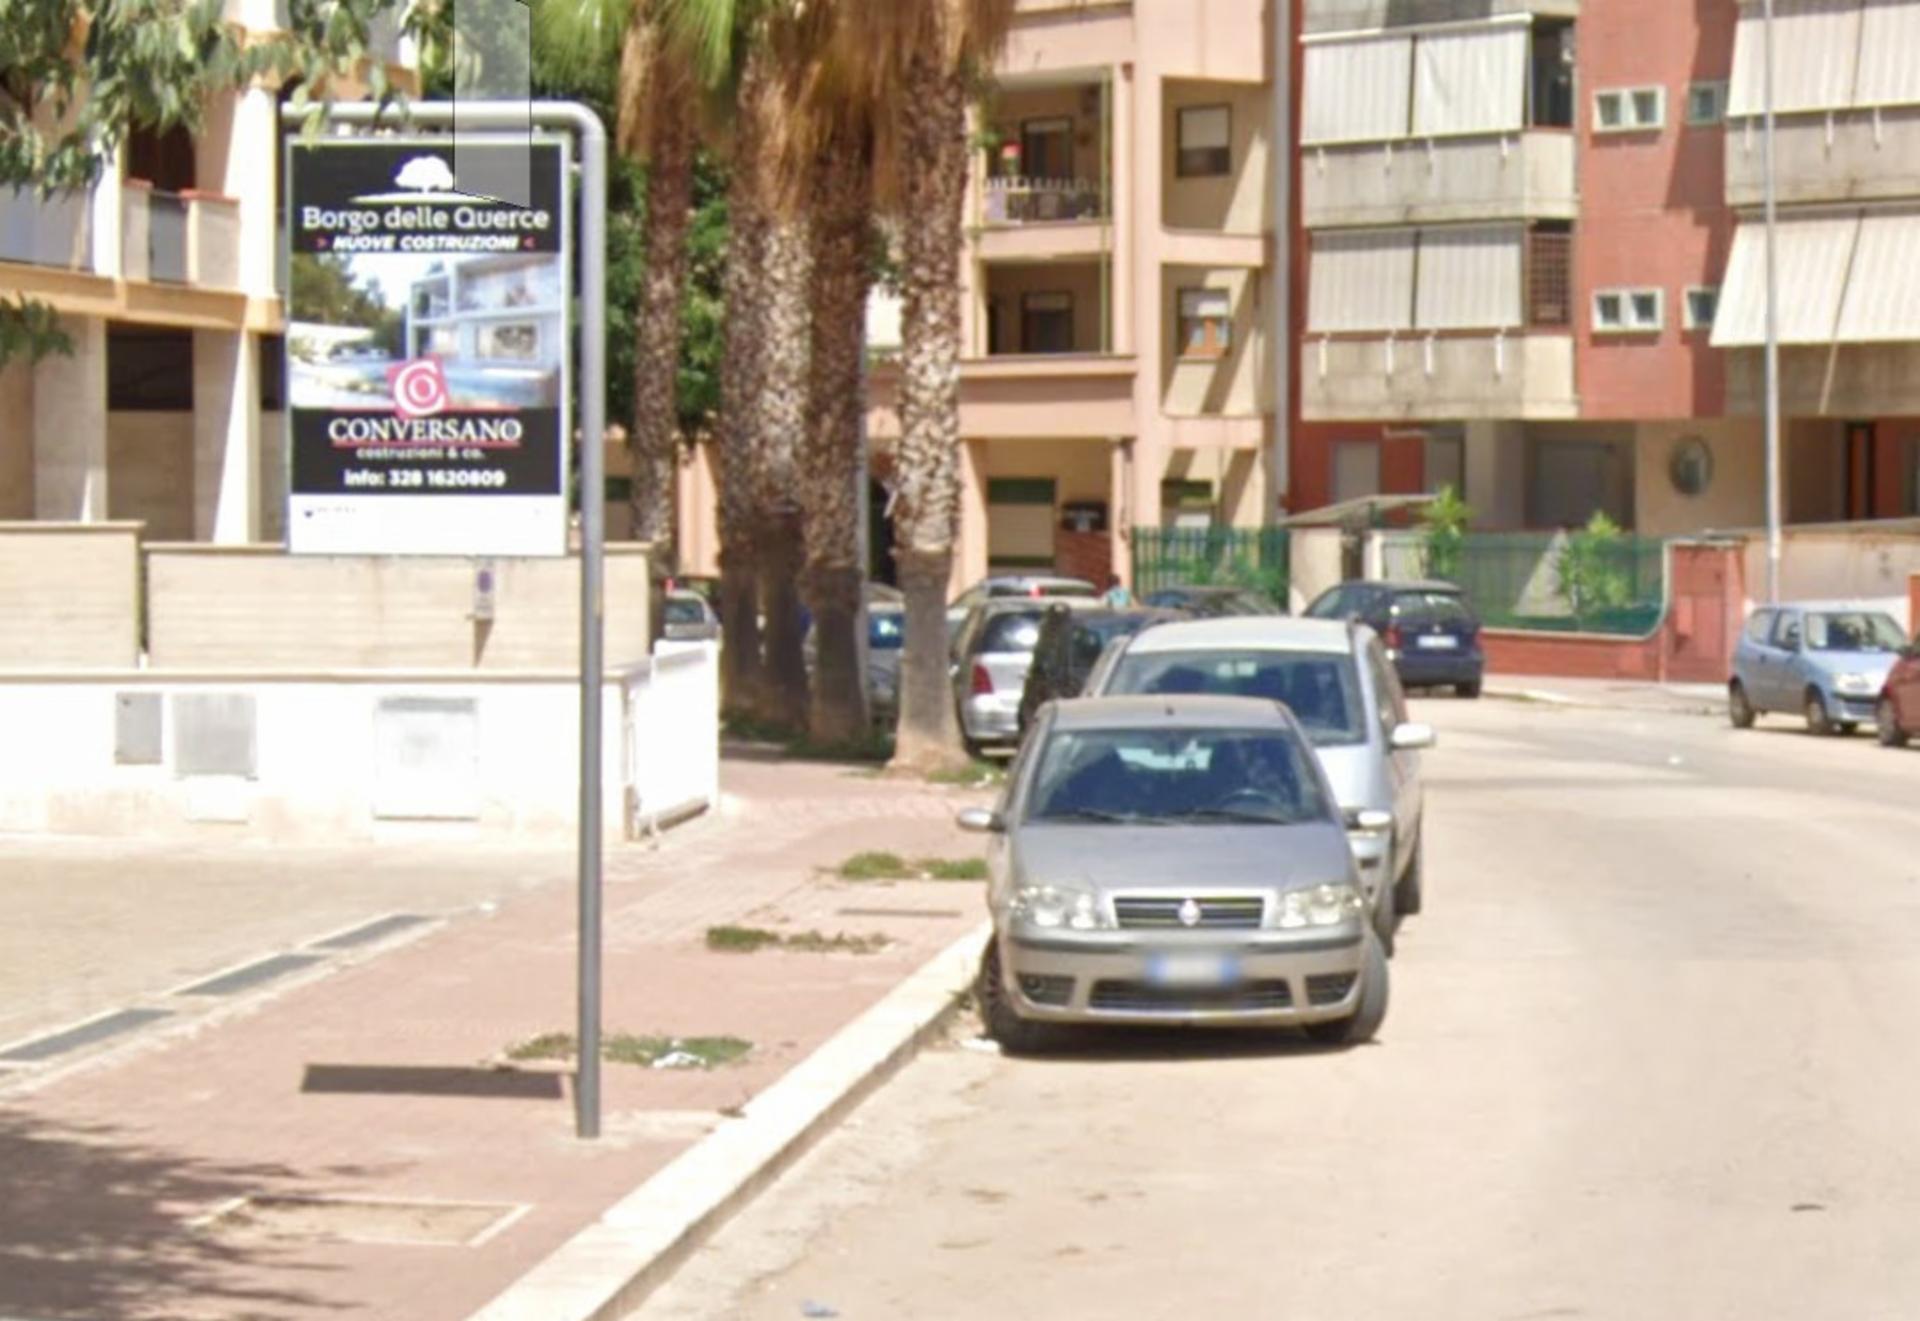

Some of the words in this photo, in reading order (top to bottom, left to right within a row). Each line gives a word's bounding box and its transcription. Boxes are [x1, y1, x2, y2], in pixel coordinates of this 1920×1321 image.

[303, 206, 379, 234] Borgo
[384, 206, 448, 229] delle
[454, 206, 549, 229] Querce
[333, 235, 396, 250] NUOVE
[400, 235, 519, 250] COSTRUZIONI
[328, 418, 523, 440] CONVERSANO
